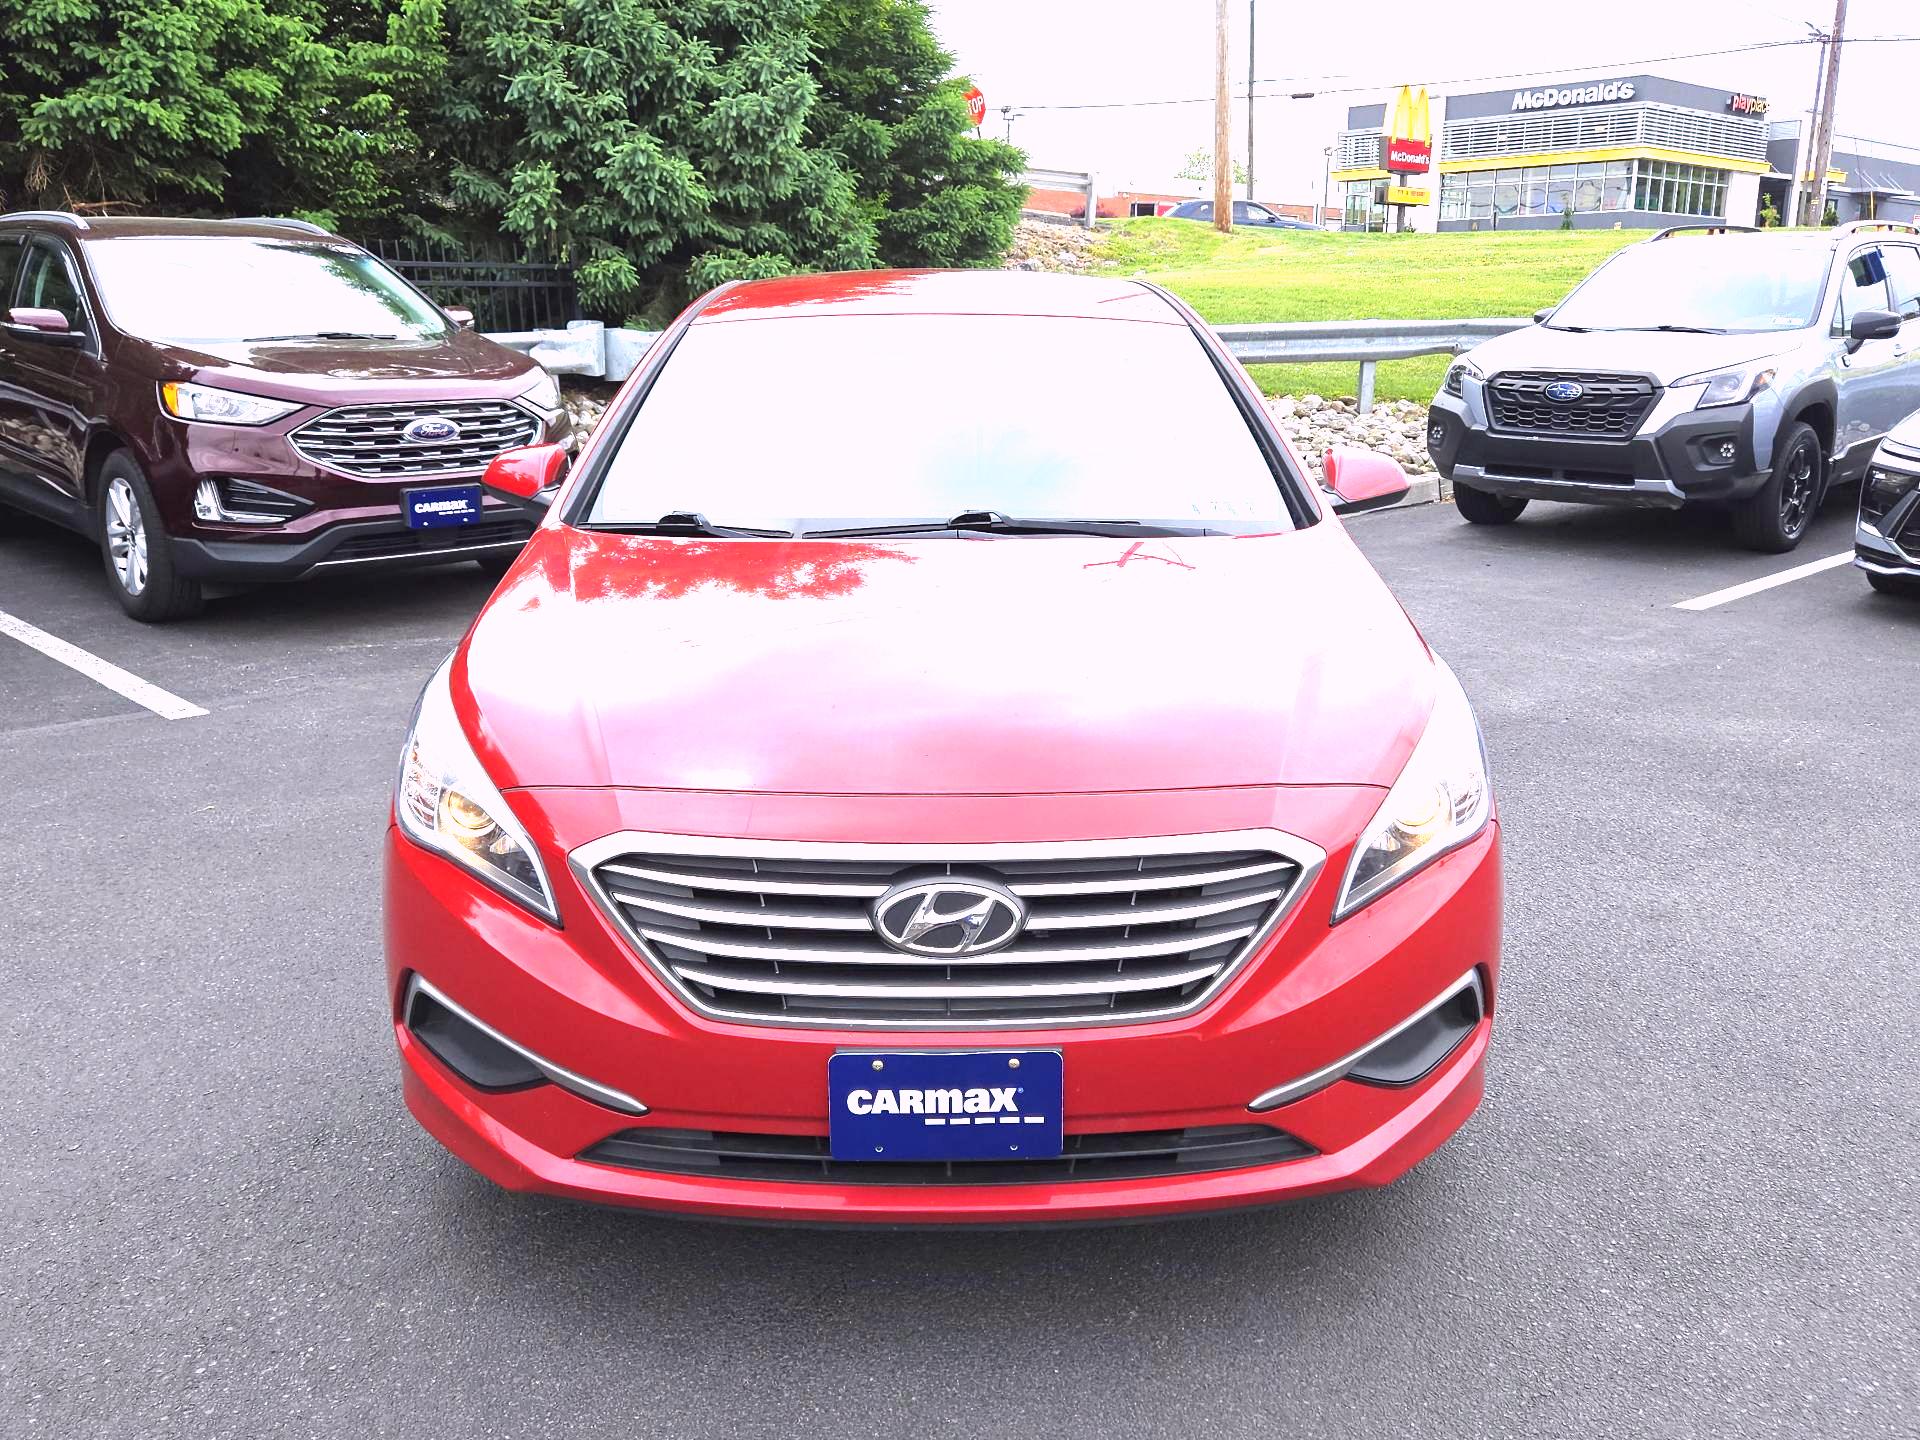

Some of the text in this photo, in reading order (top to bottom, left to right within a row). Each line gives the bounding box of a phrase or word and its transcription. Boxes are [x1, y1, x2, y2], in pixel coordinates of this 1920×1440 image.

[1511, 80, 1636, 111] McDonald's
[966, 96, 983, 116] TOP
[1391, 150, 1430, 164] McDonald's
